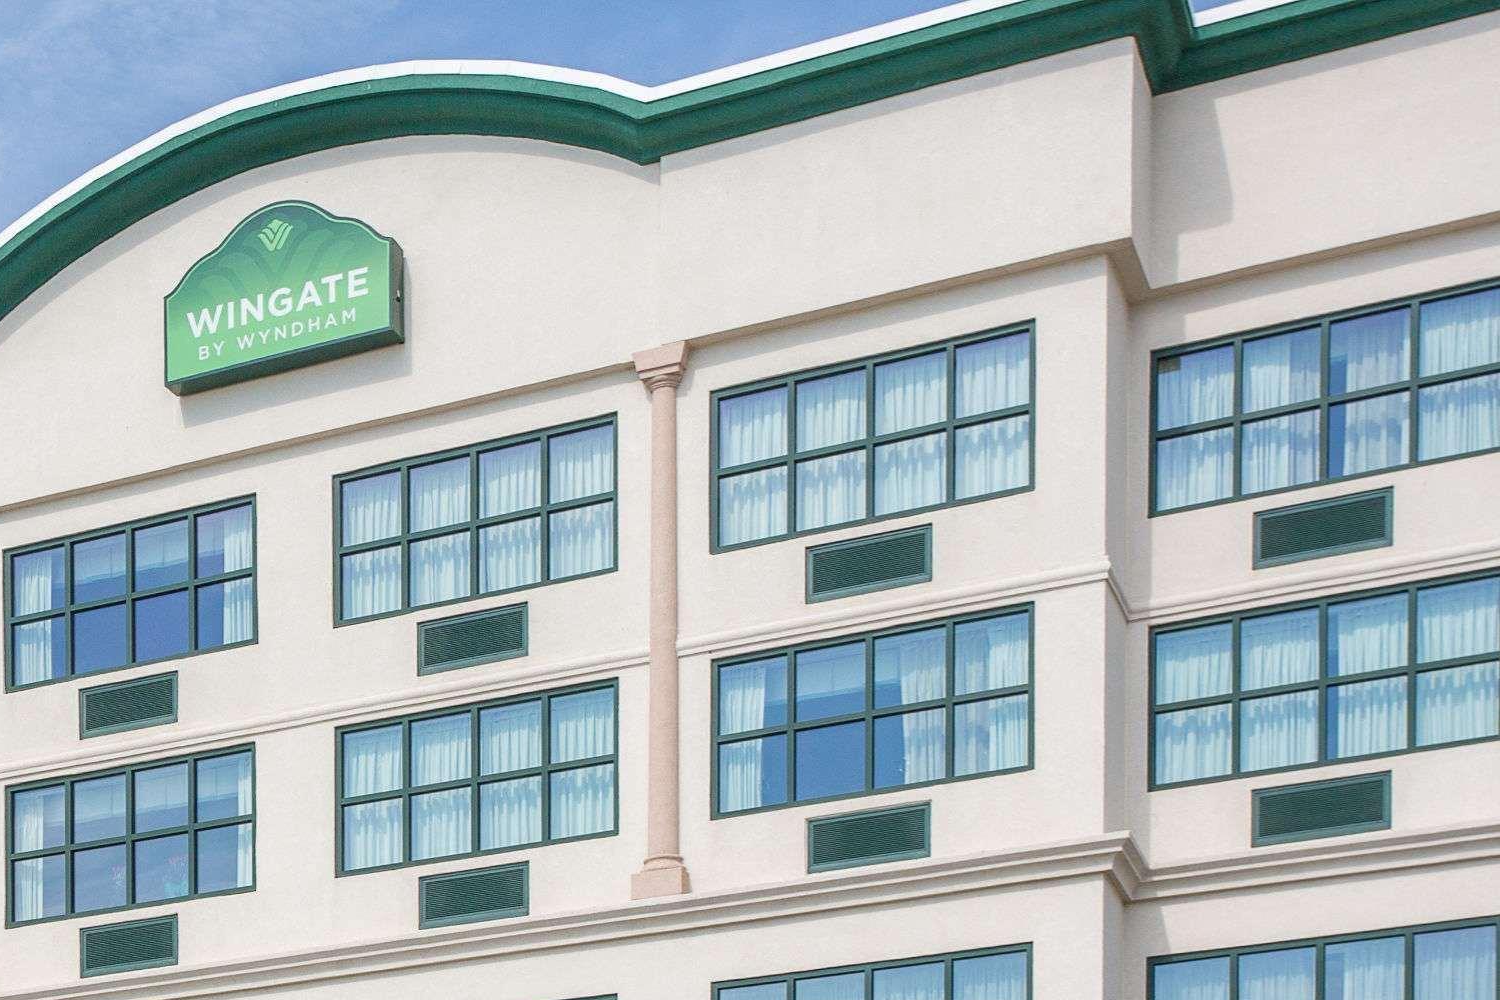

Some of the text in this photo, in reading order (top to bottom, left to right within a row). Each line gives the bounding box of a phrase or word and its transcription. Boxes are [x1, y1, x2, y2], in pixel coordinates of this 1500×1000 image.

[186, 266, 369, 338] WINGATE
[198, 307, 356, 361] BY WYNDHAM
